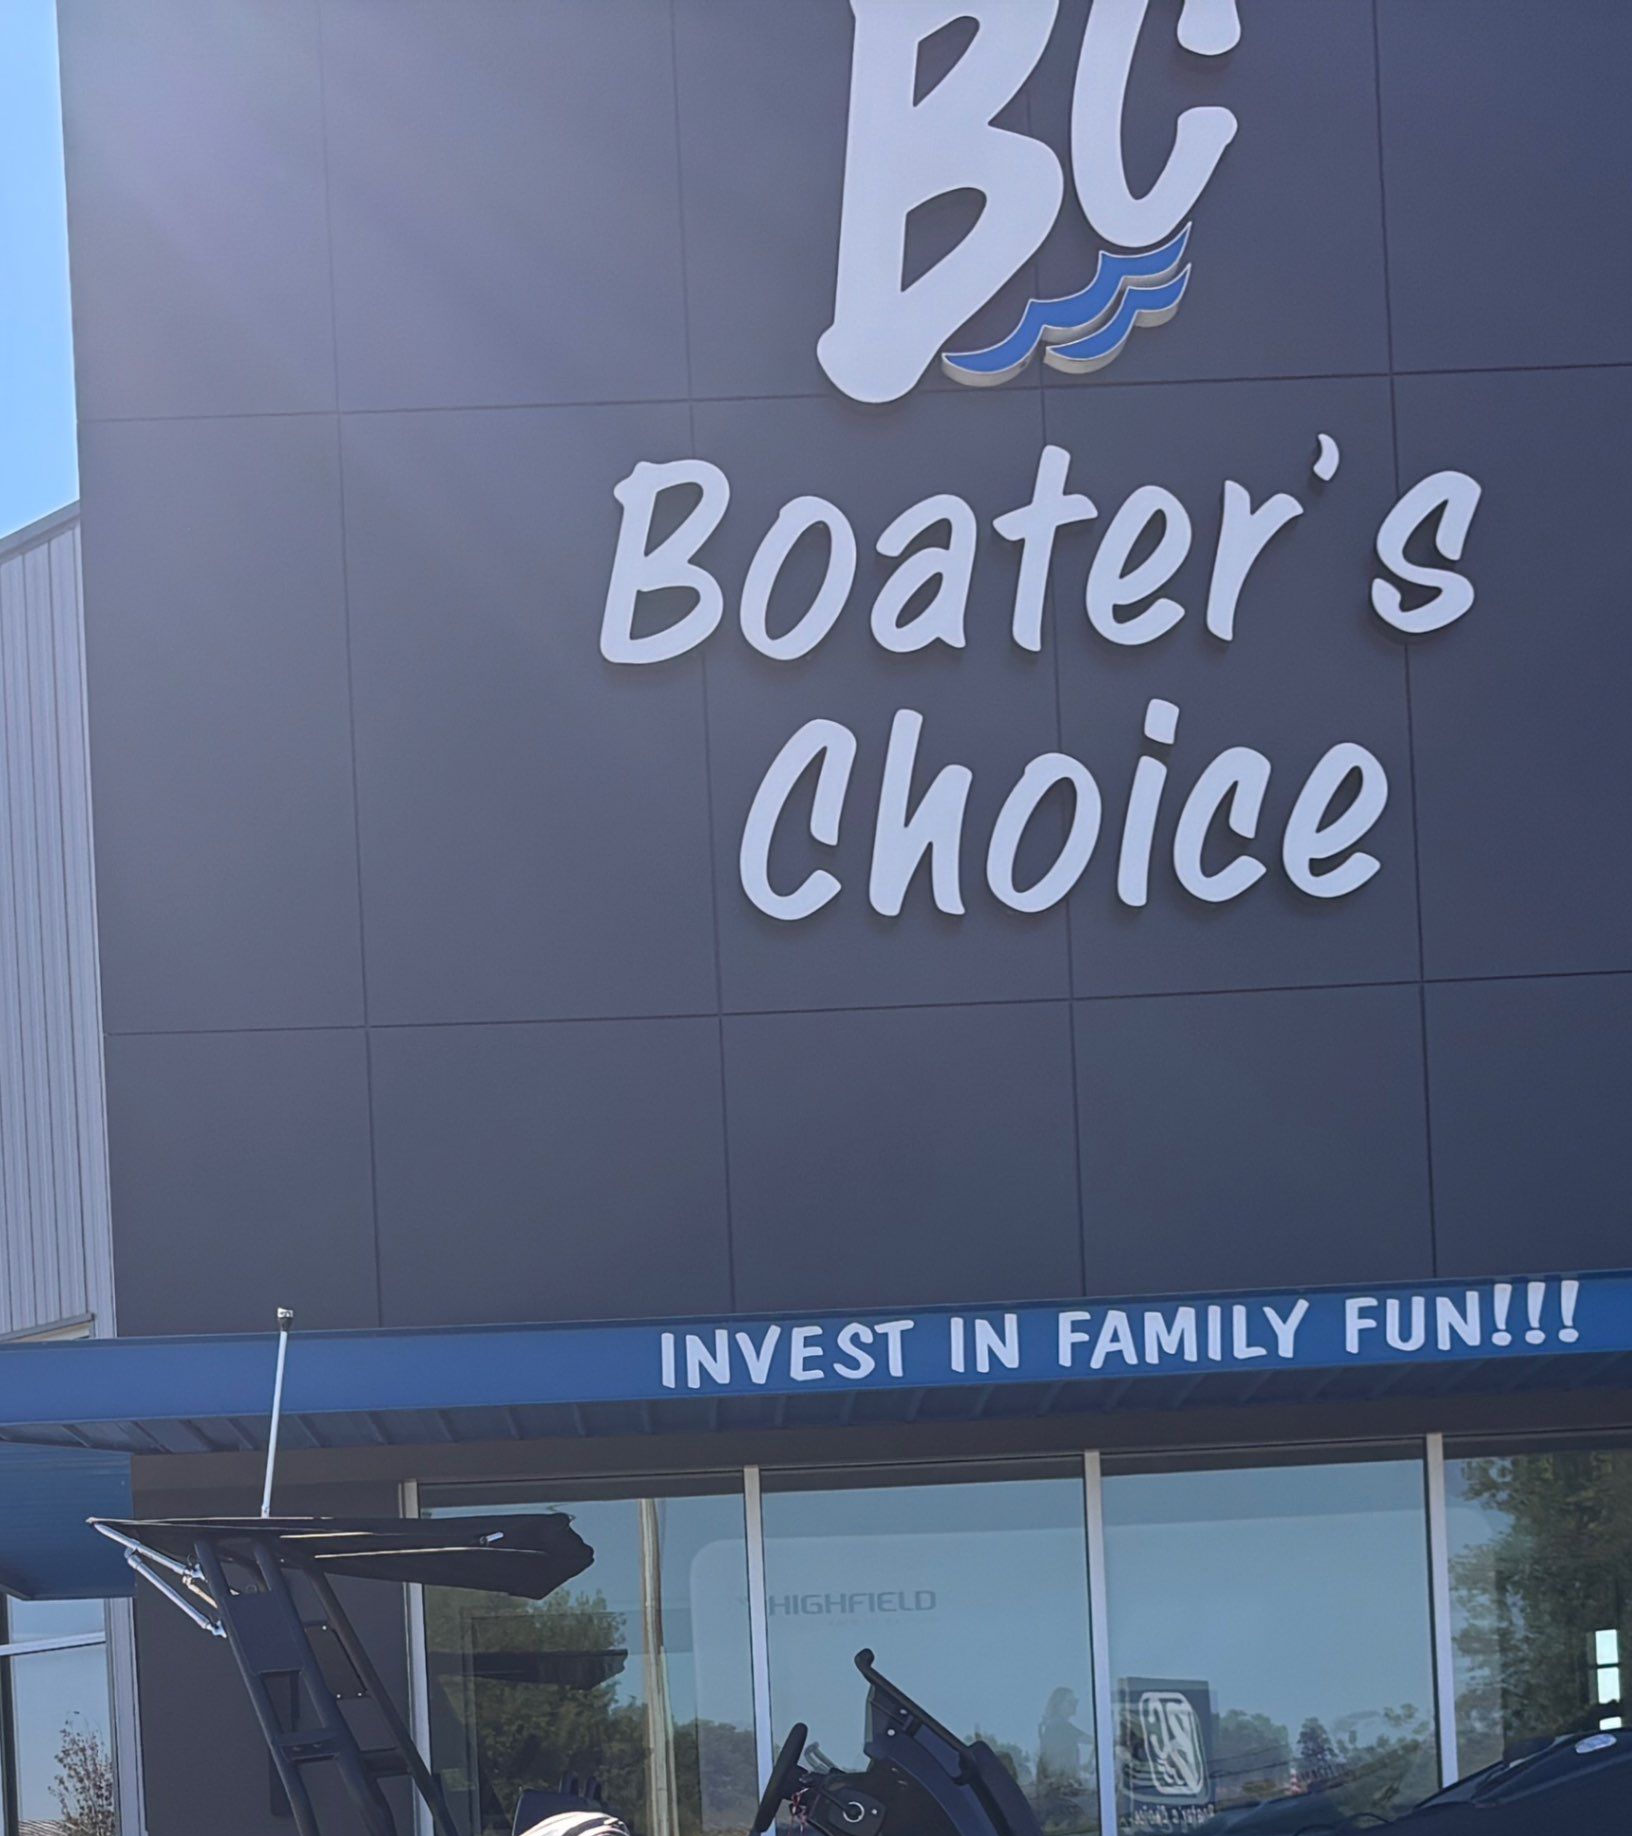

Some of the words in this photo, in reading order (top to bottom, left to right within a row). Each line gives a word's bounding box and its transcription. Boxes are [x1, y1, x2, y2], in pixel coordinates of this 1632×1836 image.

[599, 432, 1482, 665] Boater's
[739, 697, 1389, 920] Choice
[660, 1319, 915, 1390] INVEST
[949, 1312, 1020, 1374] IN
[1057, 1298, 1310, 1370] FAMILY
[1344, 1279, 1580, 1354] FUN!!!
[768, 1590, 937, 1617] HIGHFIELD
